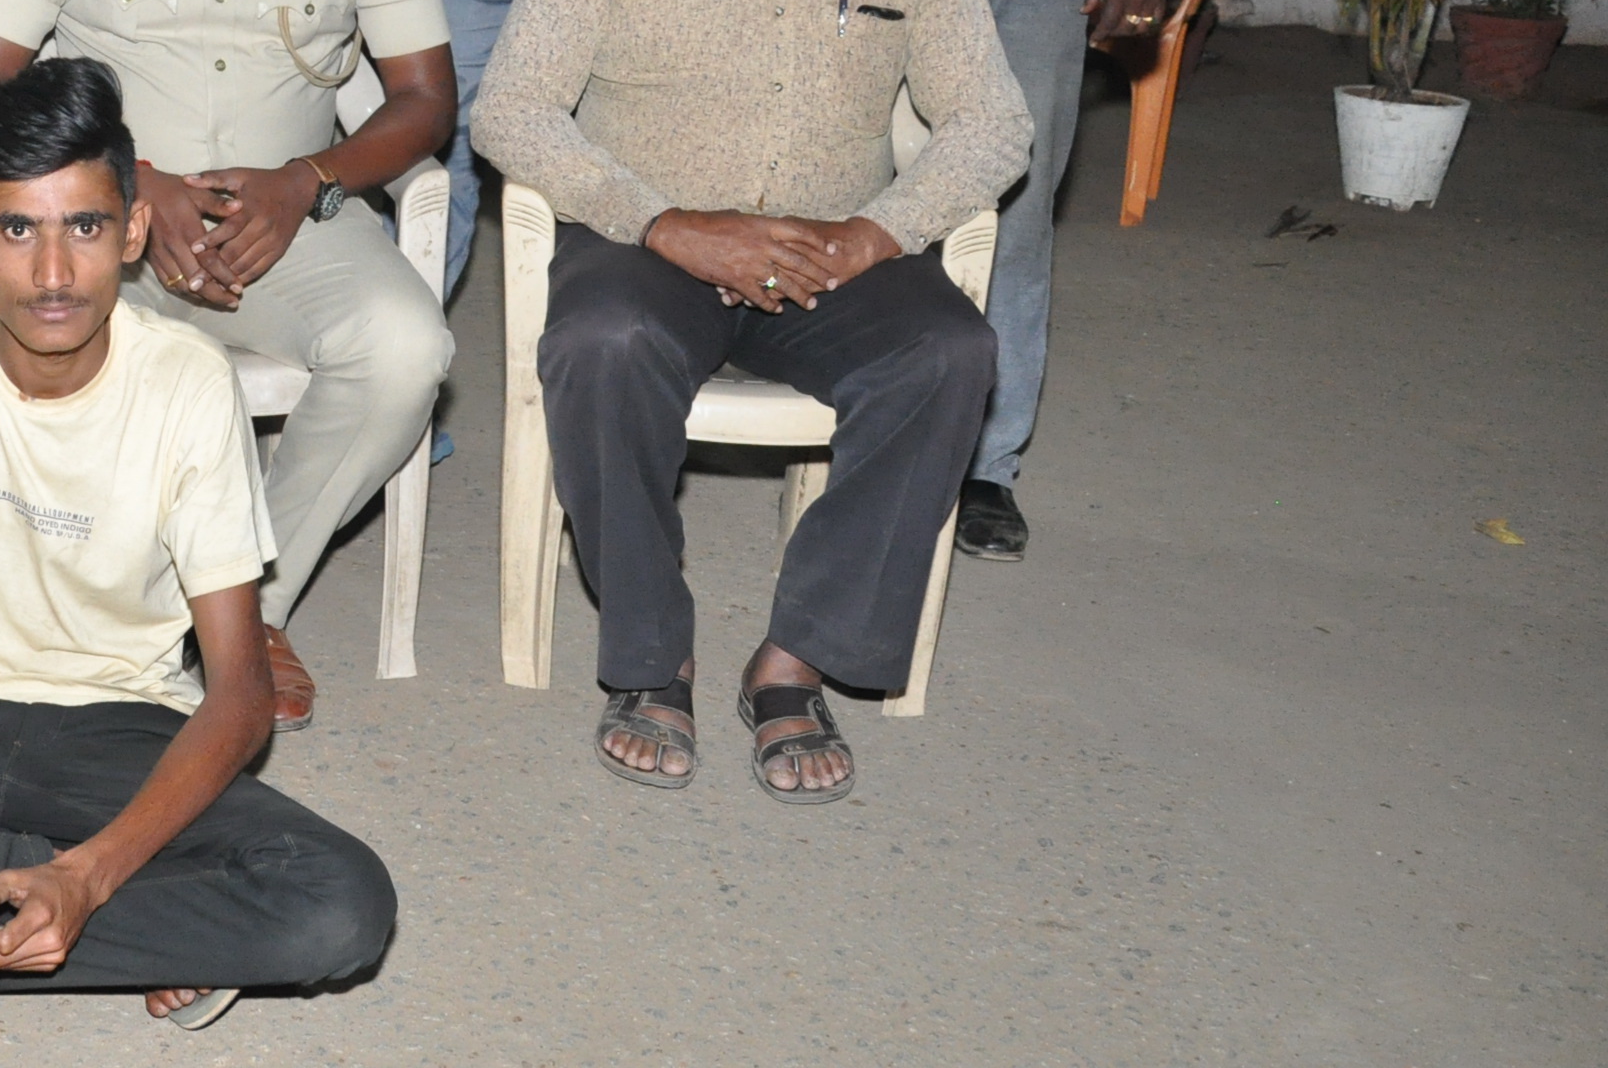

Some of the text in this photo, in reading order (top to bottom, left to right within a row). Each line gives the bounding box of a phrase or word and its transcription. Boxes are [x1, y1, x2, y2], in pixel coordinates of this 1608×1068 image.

[14, 507, 92, 534] HAND DYED INDIGO
